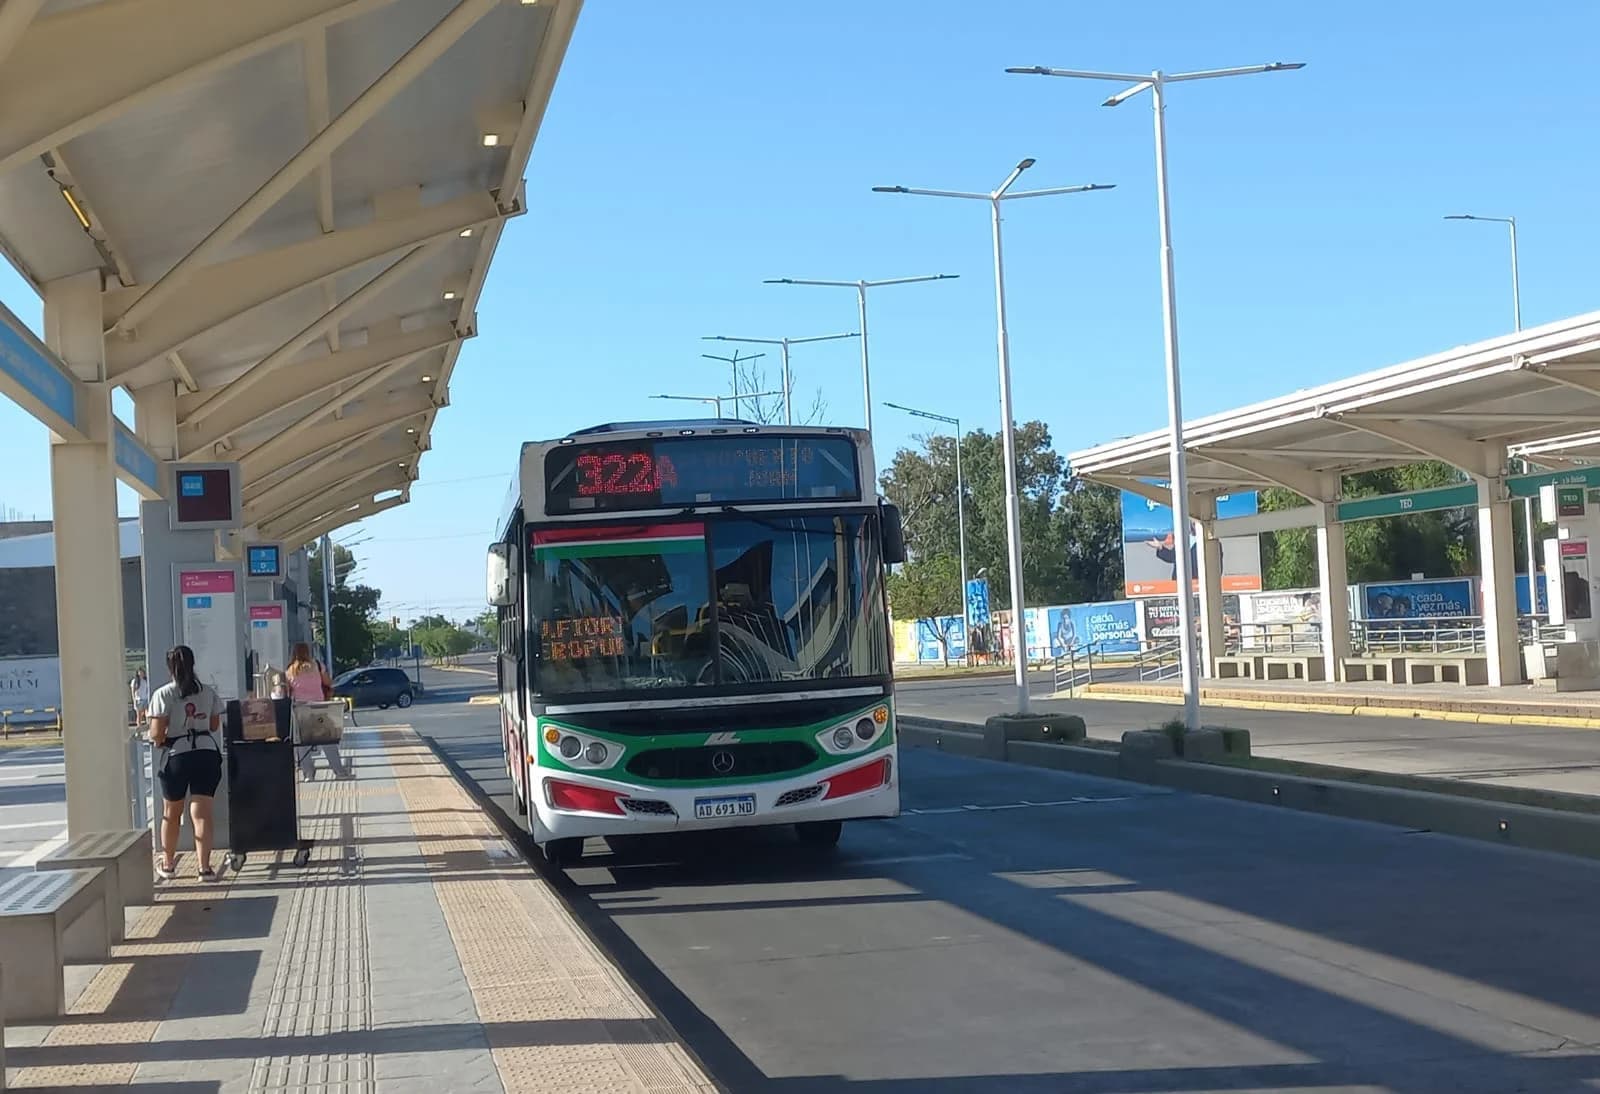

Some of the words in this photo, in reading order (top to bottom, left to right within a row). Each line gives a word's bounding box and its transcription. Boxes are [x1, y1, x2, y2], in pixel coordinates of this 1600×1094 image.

[1416, 593, 1443, 602] cada
[1418, 602, 1436, 611] vez
[1437, 600, 1461, 611] más
[1091, 613, 1113, 623] cada
[1091, 622, 1107, 632] vez
[1108, 620, 1129, 631] más
[1093, 630, 1136, 641] personal
[700, 806, 711, 816] AD
[715, 803, 735, 815] 691
[738, 802, 752, 813] ND
